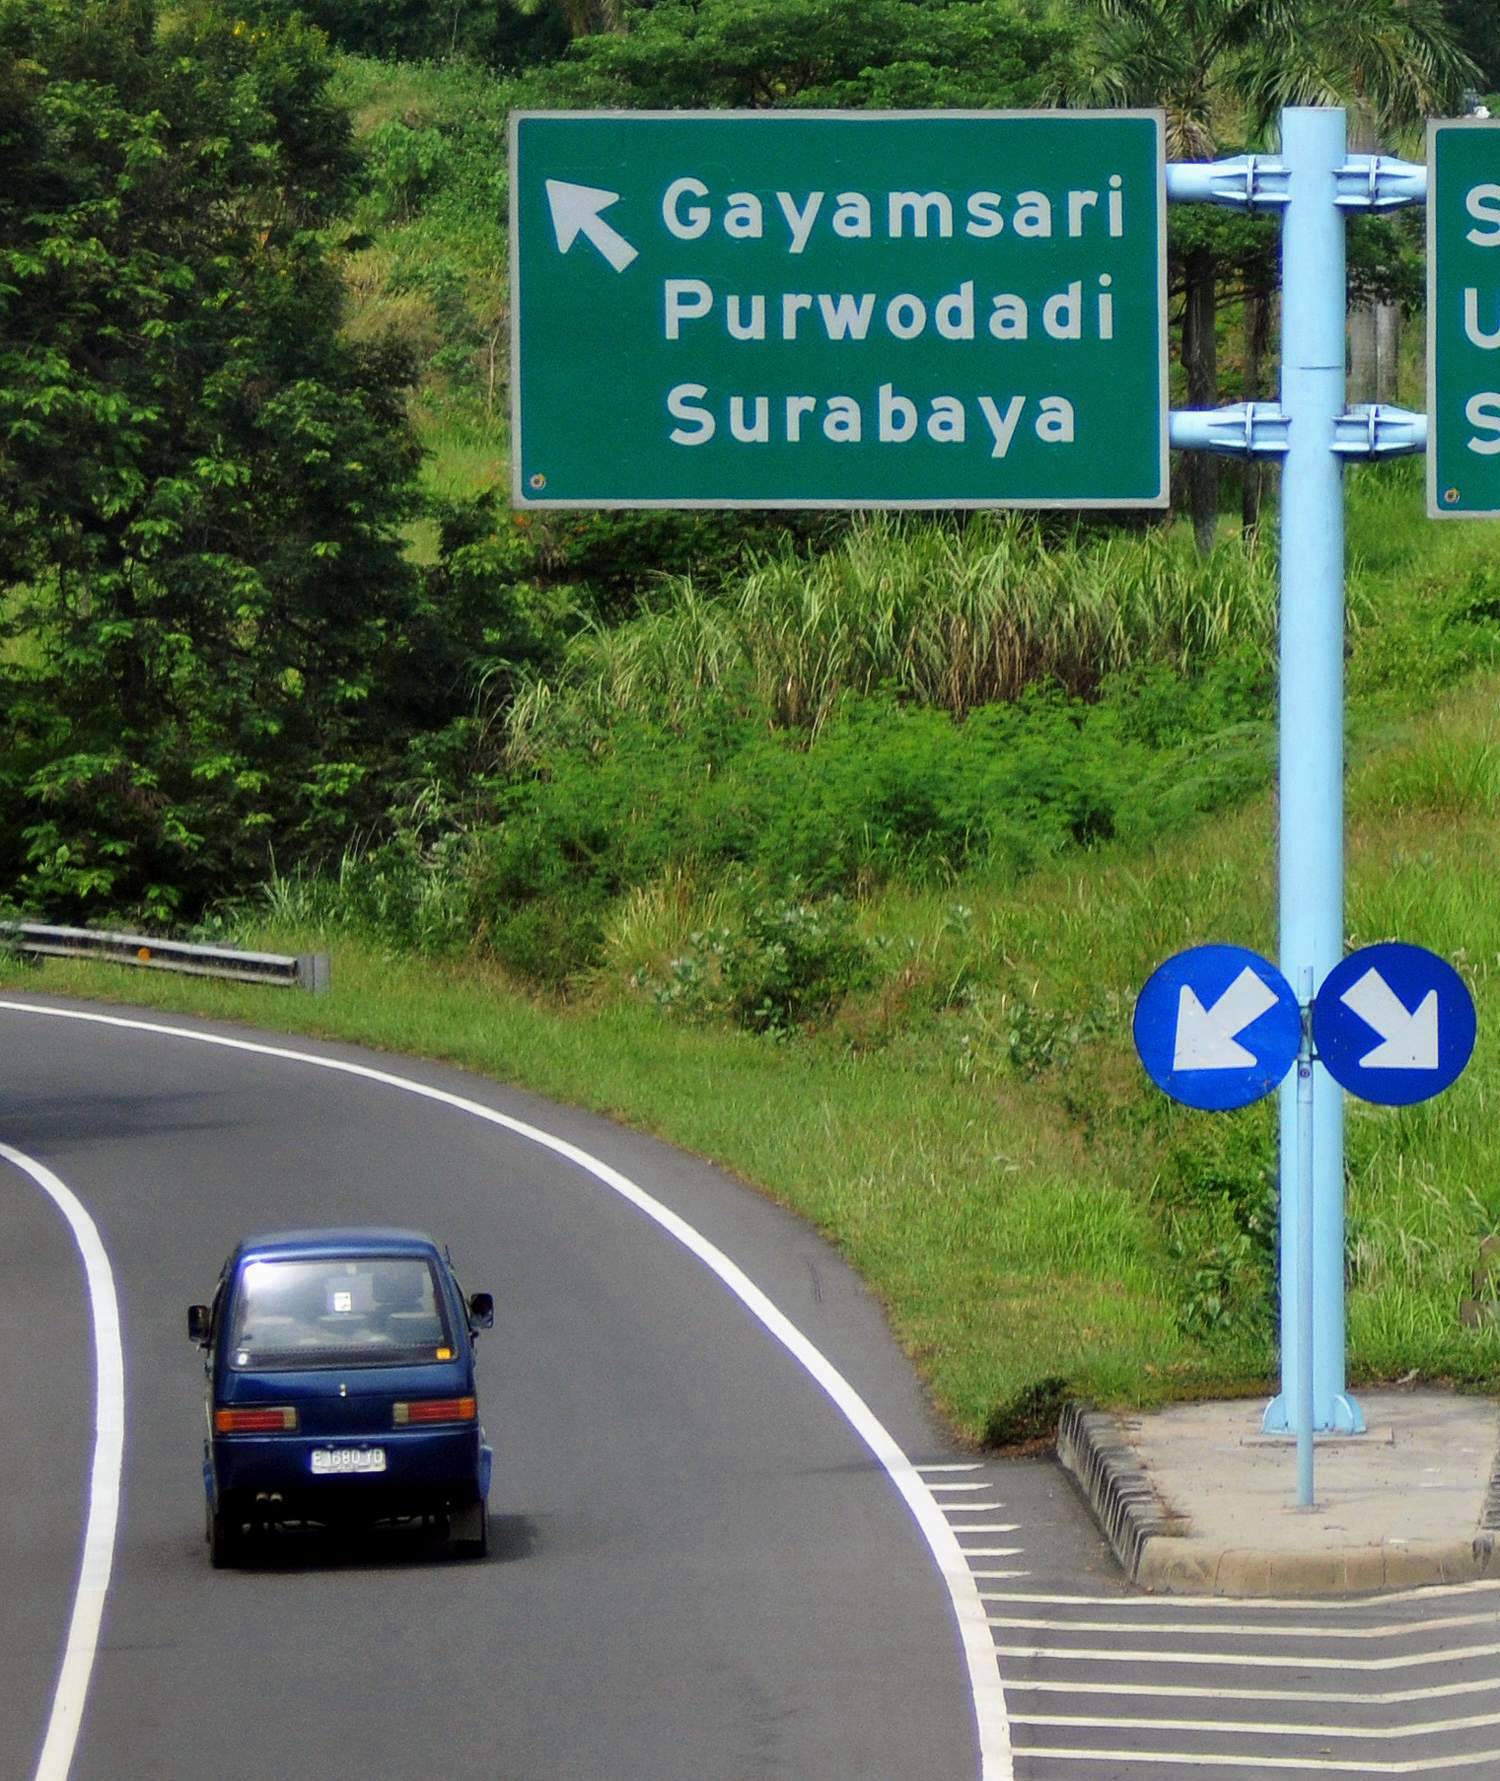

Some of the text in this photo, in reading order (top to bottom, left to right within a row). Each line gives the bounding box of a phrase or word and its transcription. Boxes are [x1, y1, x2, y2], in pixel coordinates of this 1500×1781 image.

[663, 174, 1123, 253] Gayamsari
[665, 273, 1113, 340] Purwodadi
[667, 383, 1074, 458] Surabaya
